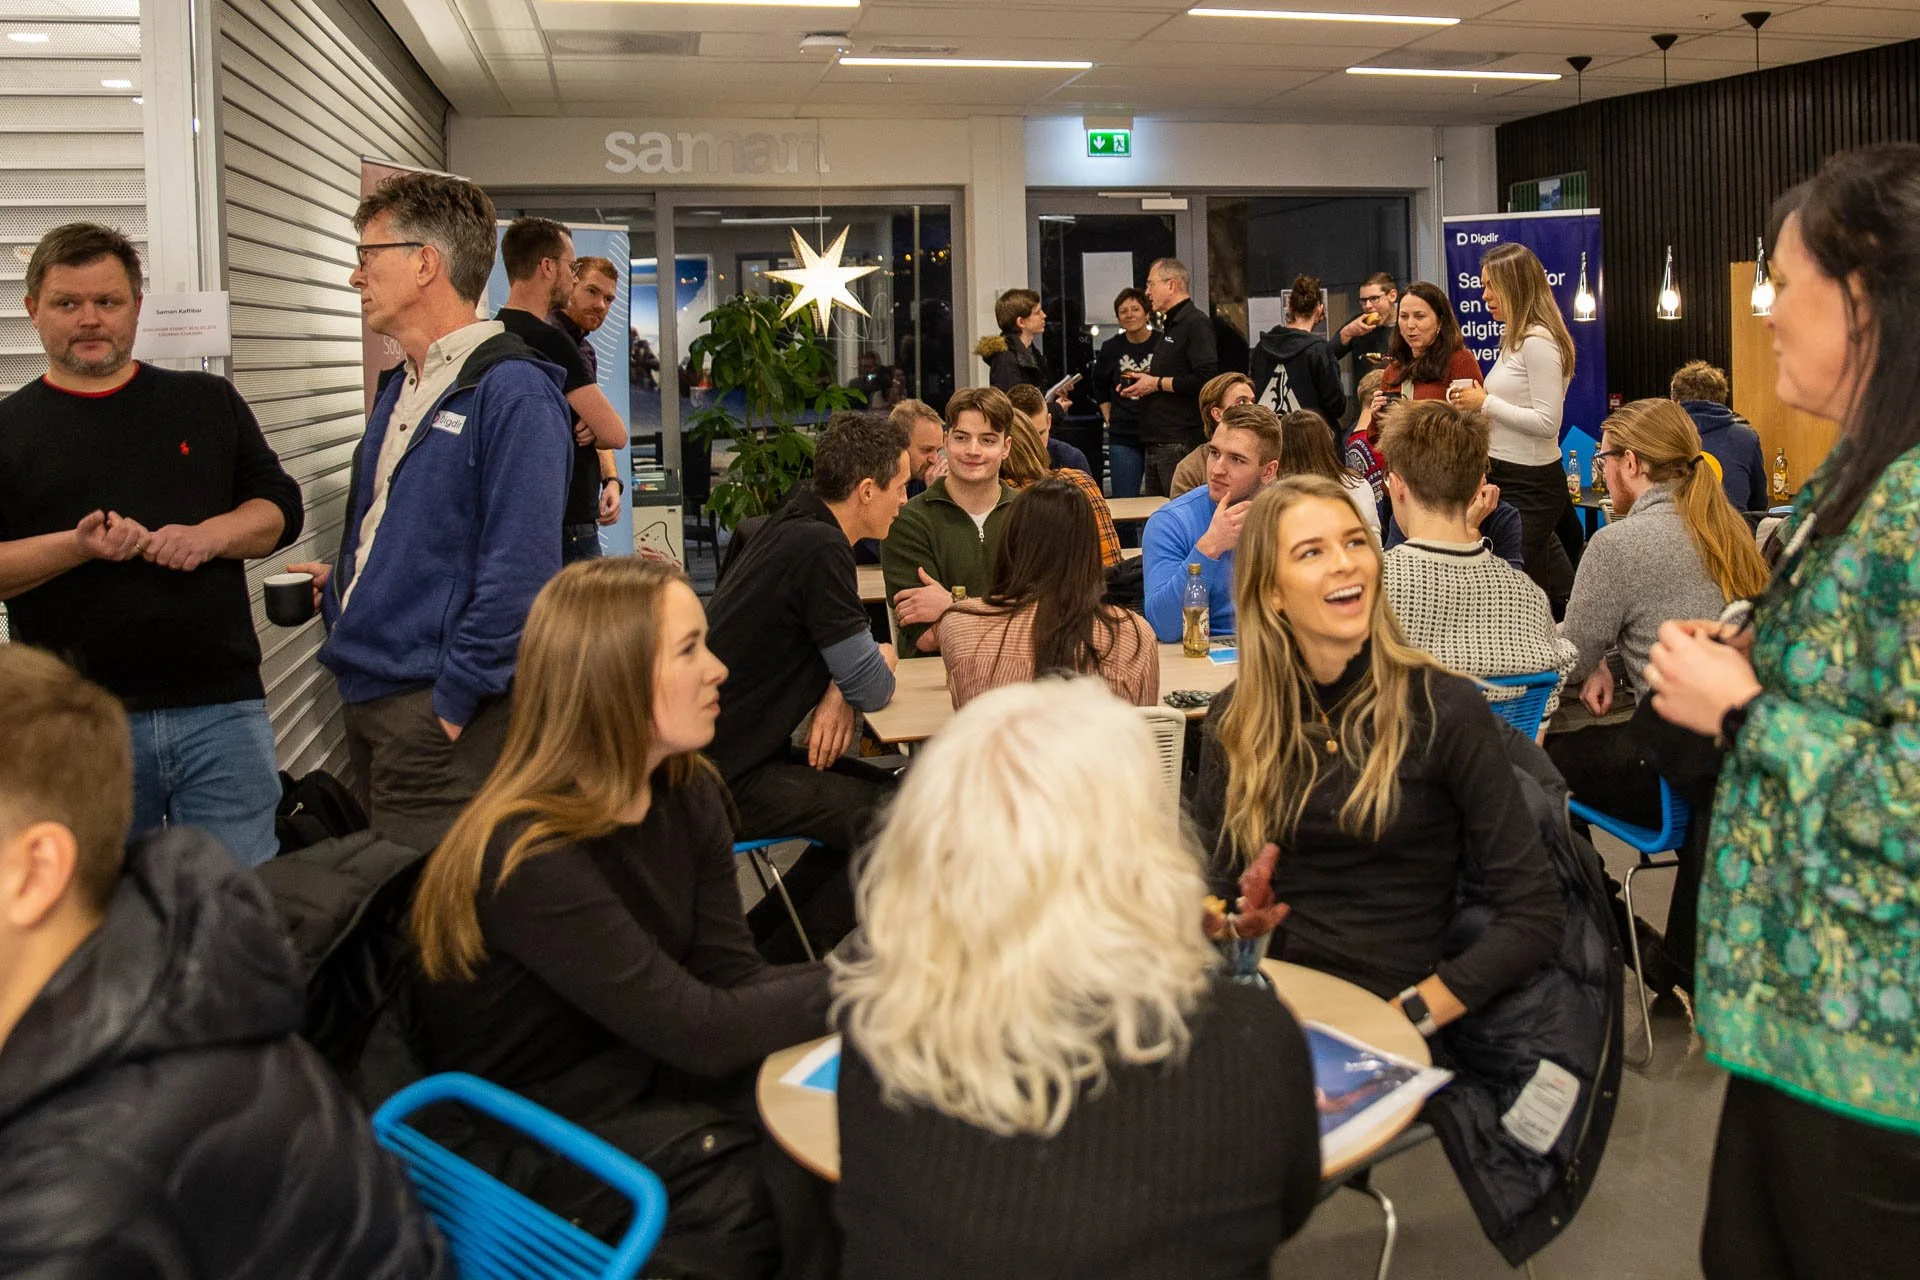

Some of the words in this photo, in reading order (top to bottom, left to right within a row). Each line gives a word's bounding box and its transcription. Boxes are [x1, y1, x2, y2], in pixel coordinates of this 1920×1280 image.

[604, 130, 831, 174] saman
[1470, 232, 1499, 245] Digdir
[1458, 272, 1485, 289] Sa
[1459, 300, 1481, 313] en
[1460, 320, 1506, 341] digita
[383, 335, 403, 359] Sog
[1472, 348, 1500, 361] ver
[439, 414, 463, 429] Digdir
